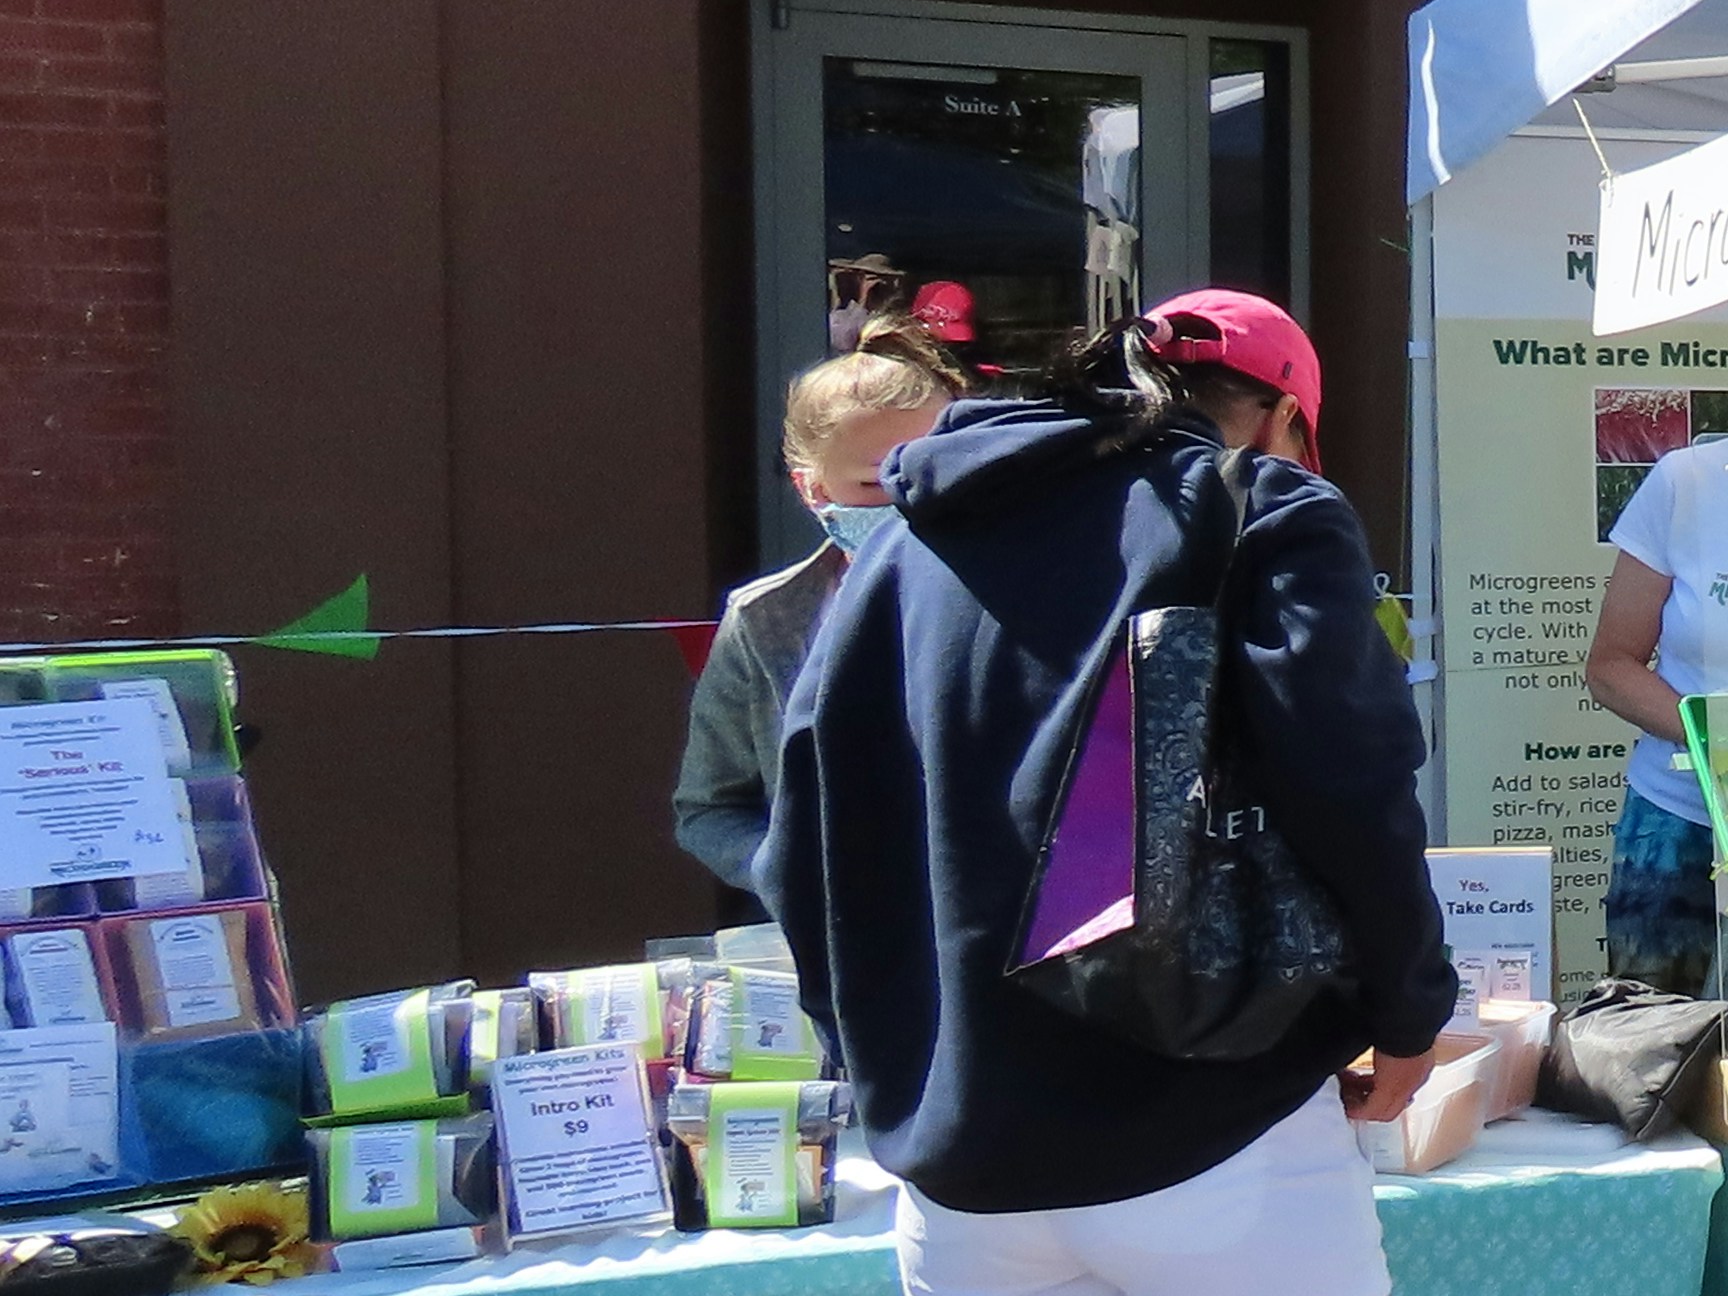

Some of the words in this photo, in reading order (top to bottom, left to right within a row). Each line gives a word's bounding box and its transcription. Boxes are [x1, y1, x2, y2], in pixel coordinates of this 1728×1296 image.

[945, 95, 999, 115] Suite
[1006, 101, 1021, 116] A
[1567, 234, 1594, 246] THE
[1493, 339, 1586, 366] What
[1596, 347, 1649, 366] are
[1469, 573, 1596, 594] Microgreens
[1471, 600, 1492, 615] at
[1499, 598, 1534, 615] the
[1542, 597, 1593, 614] most
[1473, 623, 1533, 643] cycle.
[1541, 622, 1588, 639] With
[1472, 651, 1485, 664] a
[1492, 649, 1569, 664] mature
[1505, 673, 1540, 689] not
[1547, 672, 1588, 690] only
[1524, 742, 1581, 761] How
[1587, 742, 1627, 759] are
[1492, 774, 1532, 792] Add
[1540, 776, 1561, 791] to
[1492, 800, 1571, 818] stir-fry,
[1580, 797, 1617, 813] rice
[1493, 825, 1553, 844] pizza,
[1562, 822, 1615, 839] mash
[1553, 847, 1608, 865] alties,
[1459, 879, 1490, 892] Yes,
[1553, 871, 1608, 892] green
[1446, 901, 1485, 915] Take
[1489, 898, 1534, 914] Cards
[1555, 895, 1589, 914] ste,
[531, 1101, 580, 1117] Intro
[585, 1093, 615, 1109] Kit
[564, 1119, 589, 1137] $9
